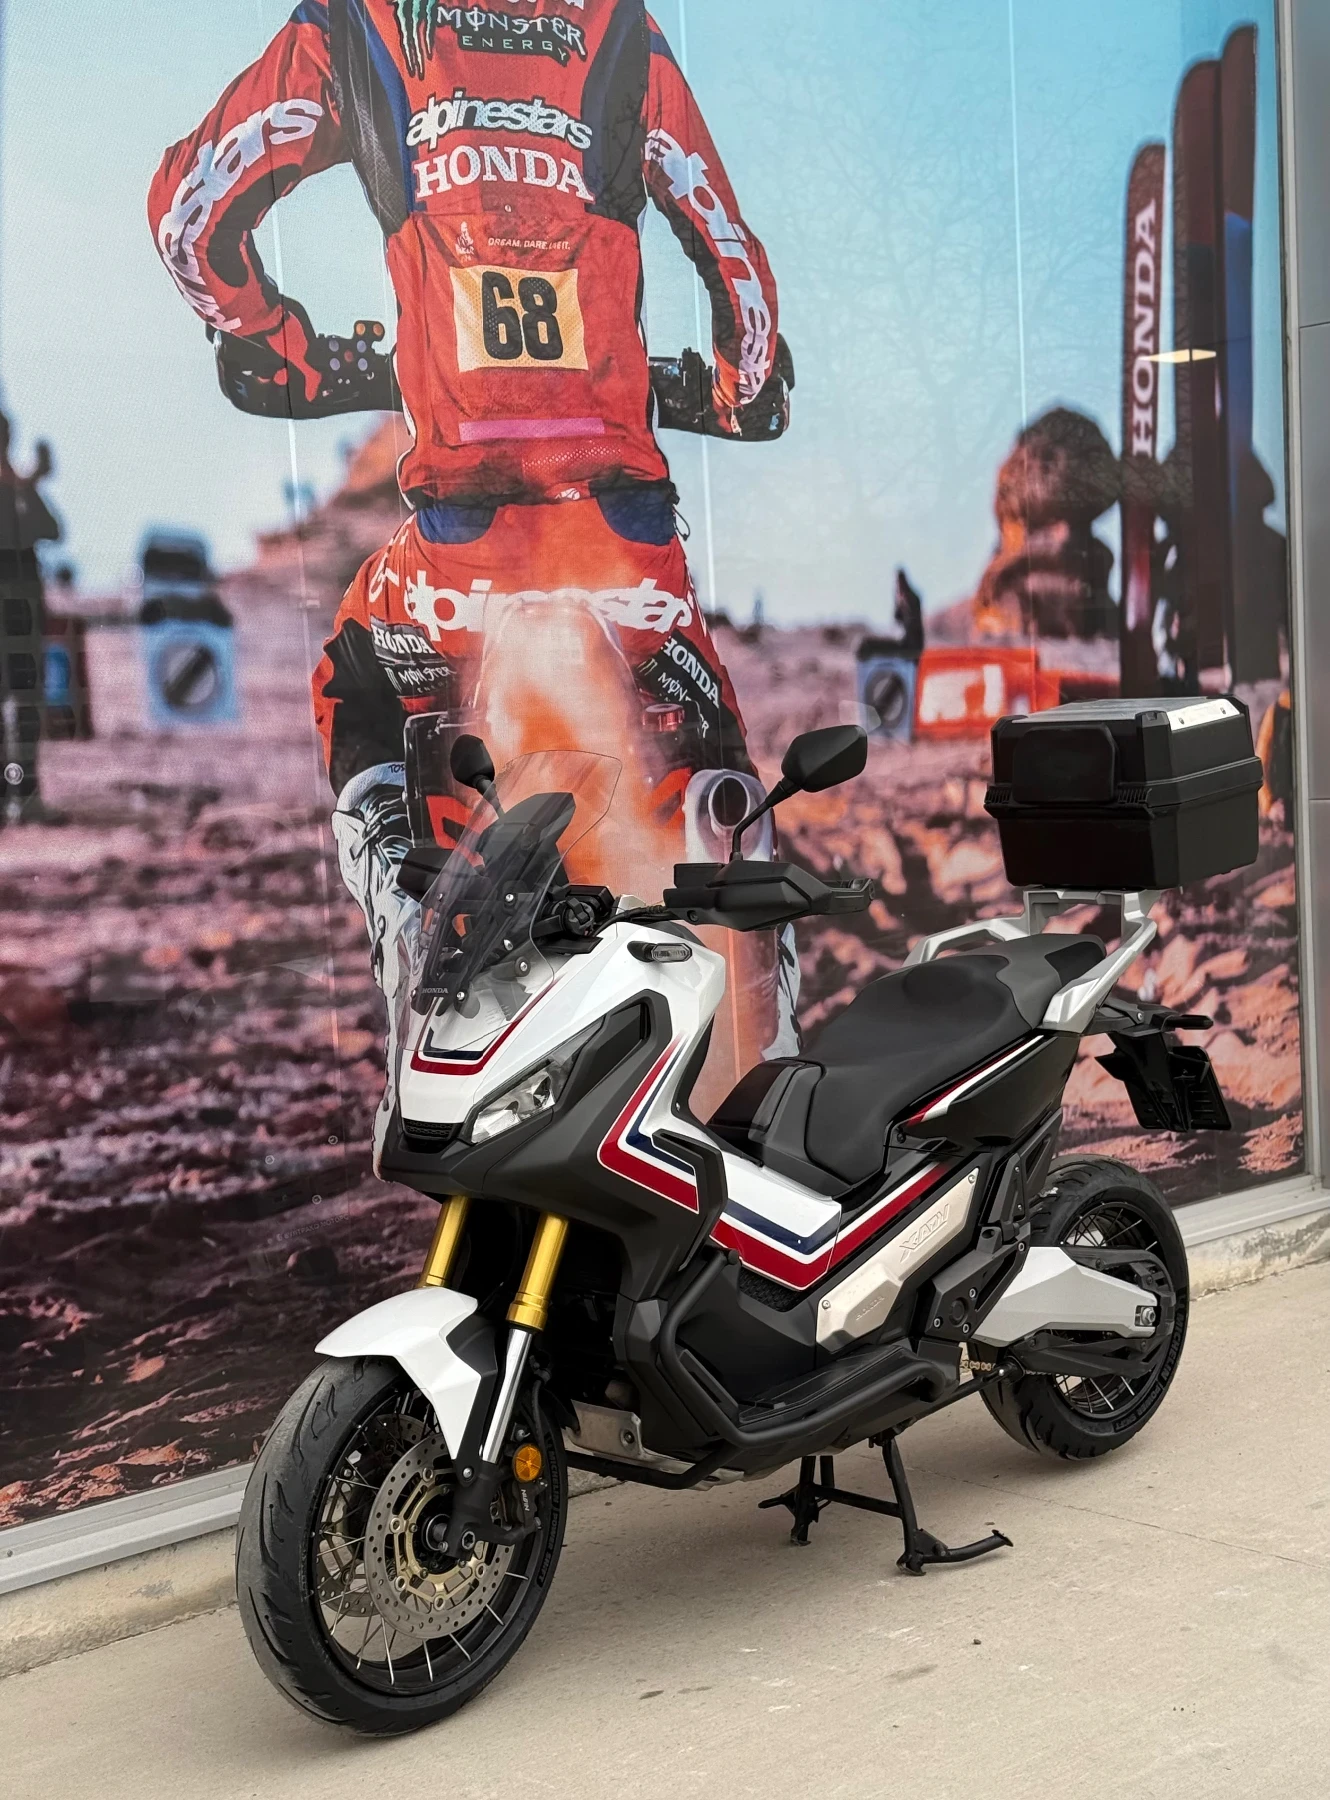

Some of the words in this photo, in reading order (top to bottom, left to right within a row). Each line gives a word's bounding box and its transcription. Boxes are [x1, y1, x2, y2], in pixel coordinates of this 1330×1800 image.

[462, 35, 568, 61] ENERGY
[406, 90, 593, 150] alpinestars
[414, 145, 595, 202] HONDA
[482, 270, 564, 361] 68
[1131, 201, 1157, 458] HONDA
[370, 623, 436, 654] HONDA
[660, 635, 720, 709] HONDA
[1161, 1313, 1185, 1381] MICHELIN
[549, 1452, 560, 1503] MICHELIN
[547, 1512, 558, 1549] POWER
